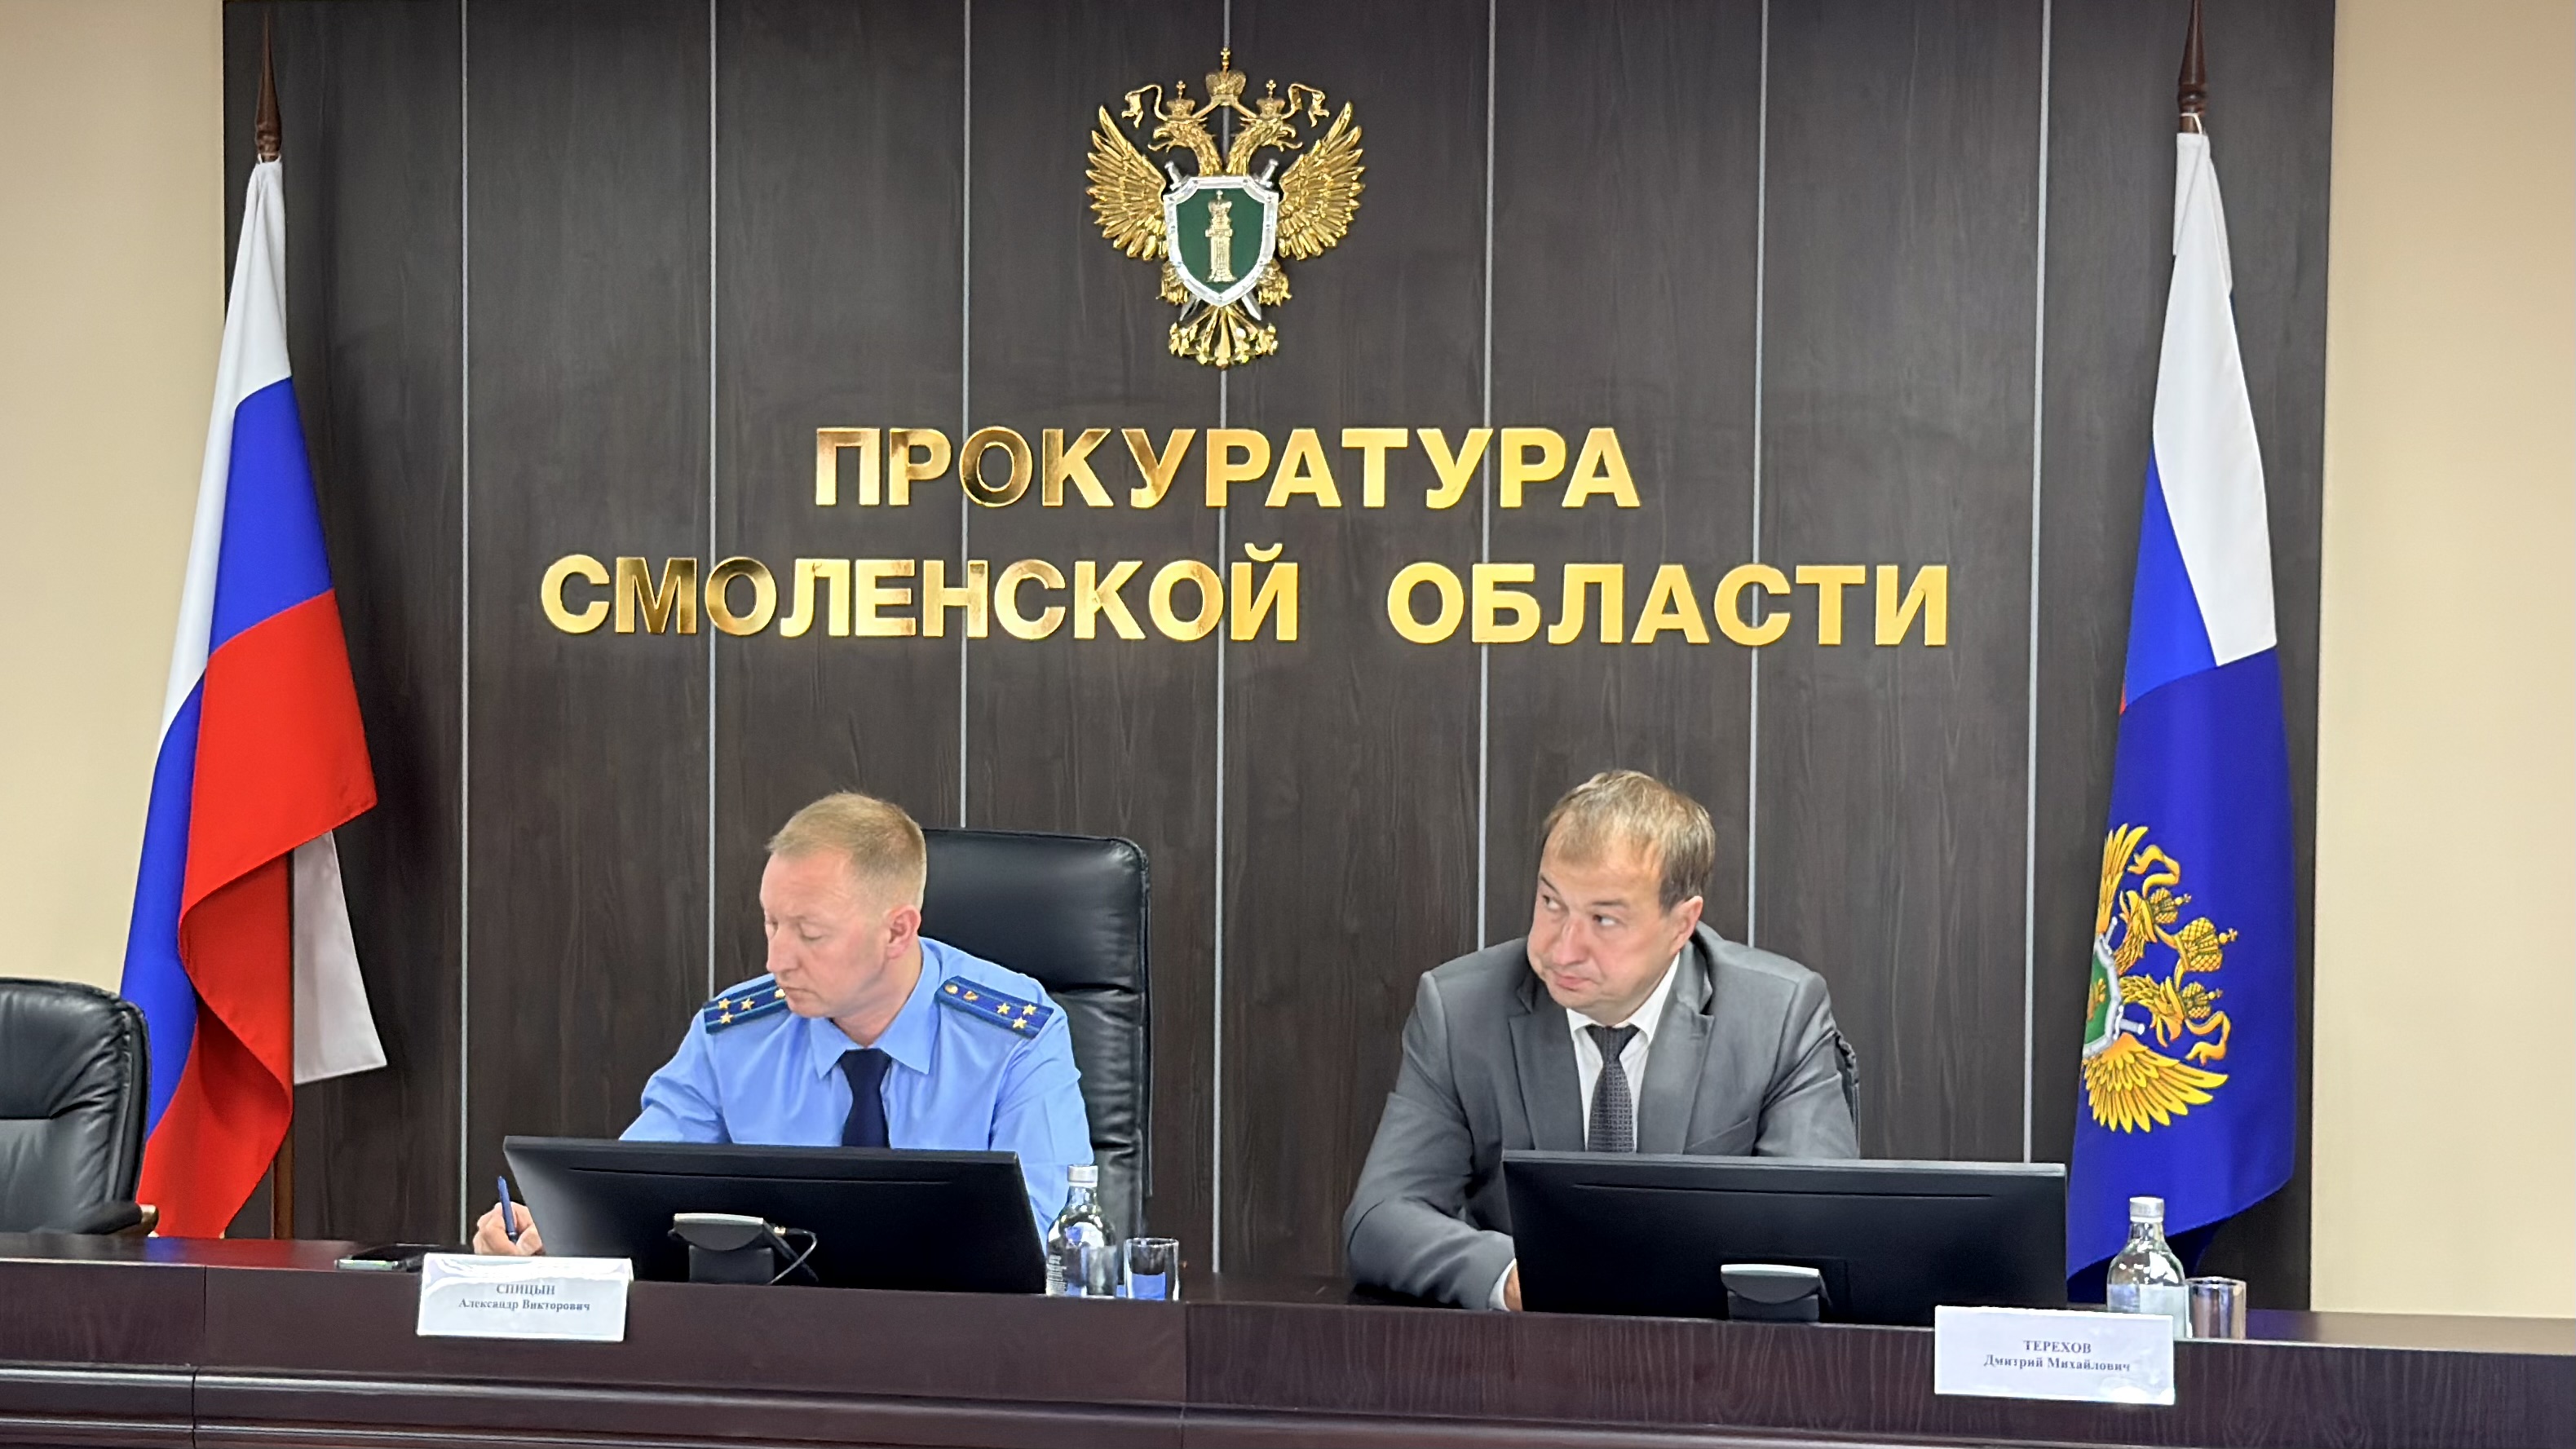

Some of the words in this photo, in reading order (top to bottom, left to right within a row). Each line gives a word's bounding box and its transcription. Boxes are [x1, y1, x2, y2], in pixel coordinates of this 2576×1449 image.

[815, 426, 1641, 508] ПРОКУРАТУРА
[541, 542, 1298, 642] СМОЛЕНСКОЙ
[1387, 562, 1947, 647] ОБЛАСТИ
[496, 1284, 555, 1296] СПИЦЫН
[458, 1298, 519, 1311] Александр
[522, 1300, 590, 1312] Викторович
[2023, 1340, 2092, 1354] ТЕРЕХОВ
[1983, 1354, 2044, 1369] Дмитрий
[2048, 1357, 2131, 1372] Михайлович
